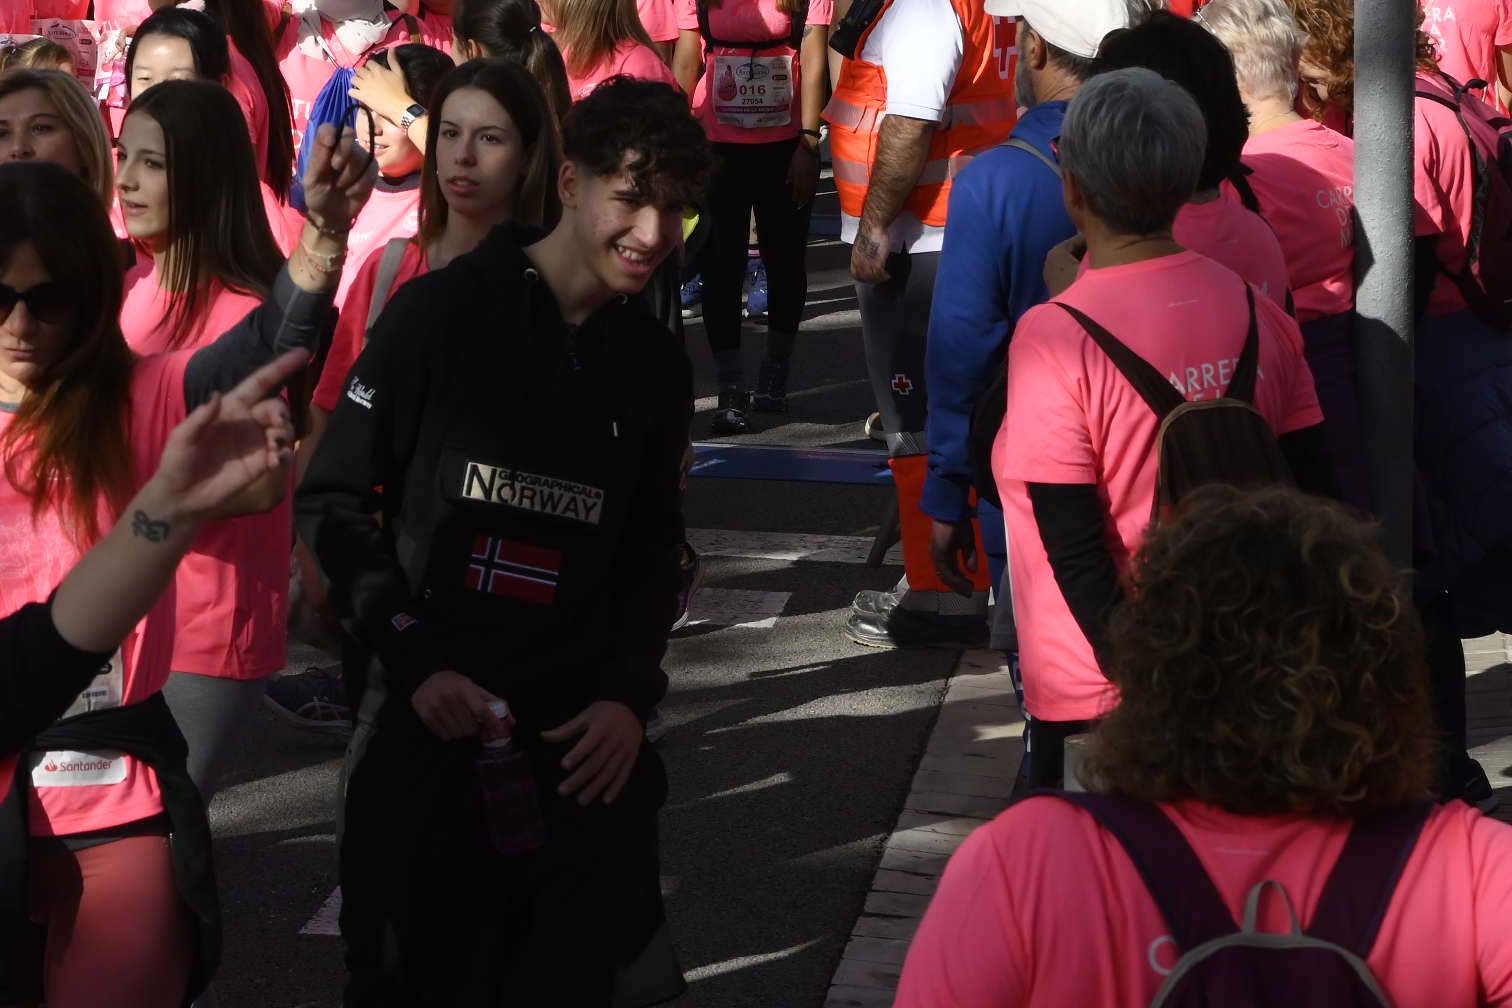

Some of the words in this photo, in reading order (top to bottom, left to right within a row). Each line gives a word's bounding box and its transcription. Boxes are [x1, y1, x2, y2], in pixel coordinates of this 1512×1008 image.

[739, 84, 766, 95] 016
[466, 463, 598, 521] NORWAY
[60, 759, 112, 773] Santander
